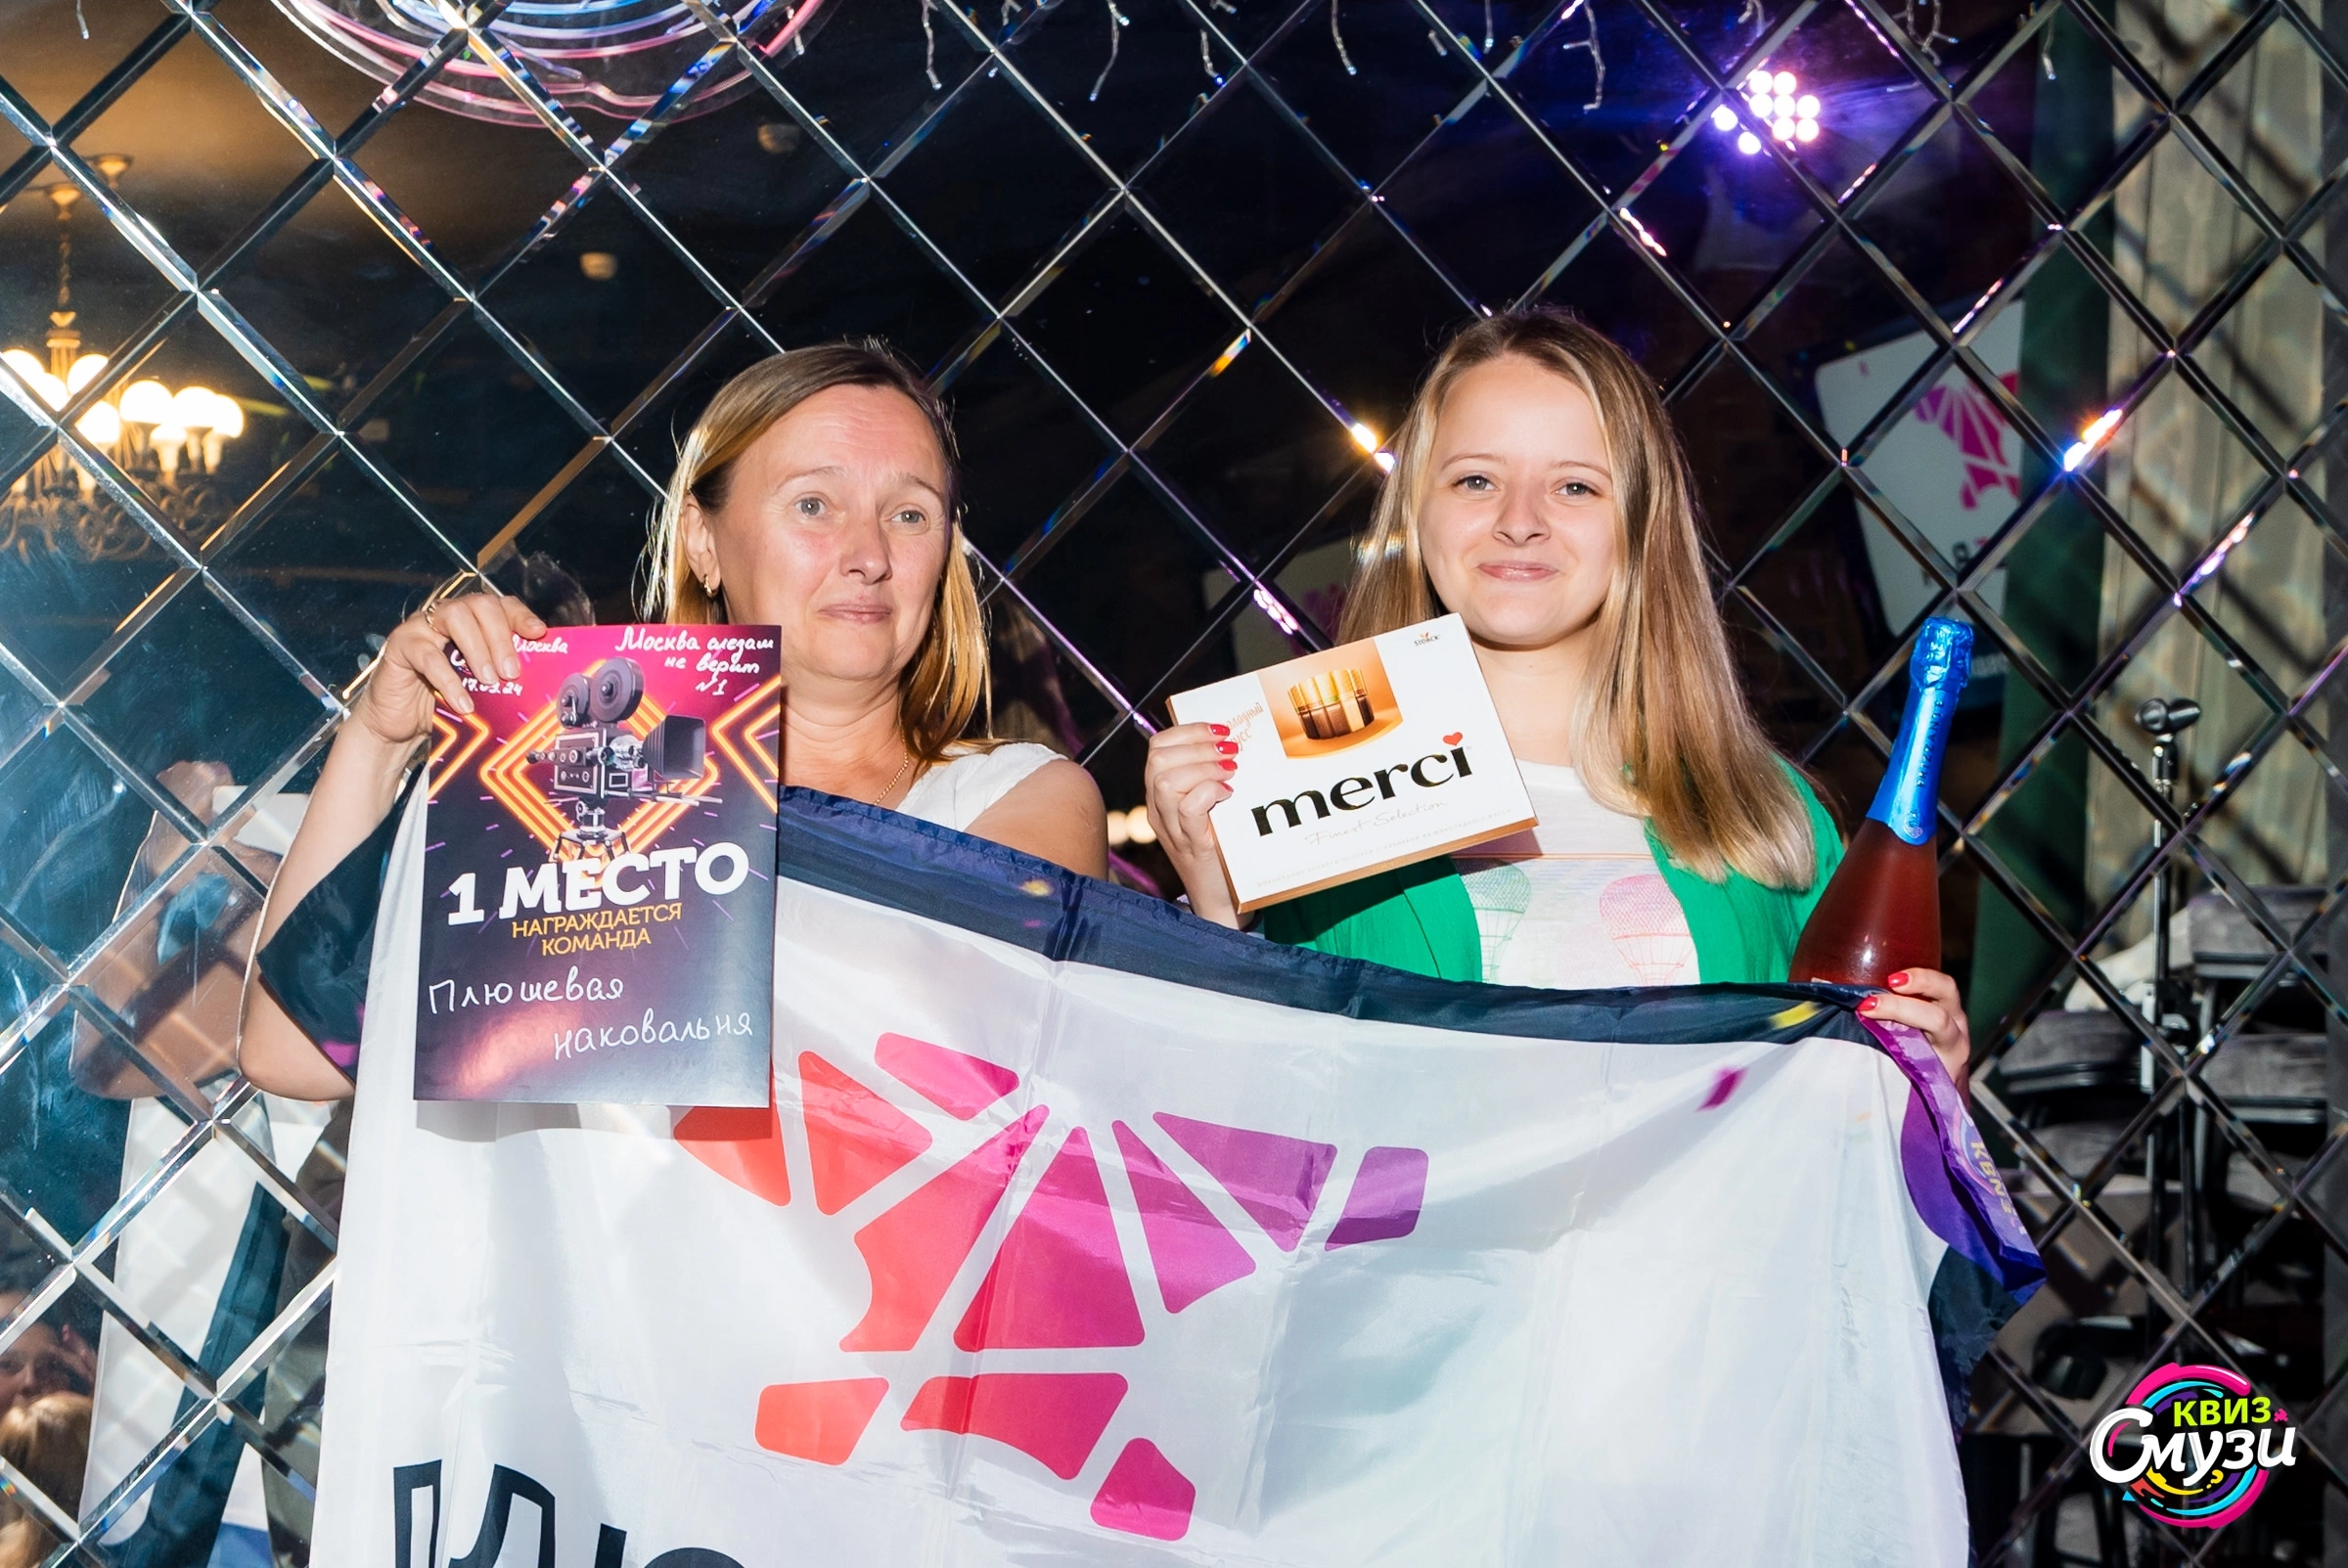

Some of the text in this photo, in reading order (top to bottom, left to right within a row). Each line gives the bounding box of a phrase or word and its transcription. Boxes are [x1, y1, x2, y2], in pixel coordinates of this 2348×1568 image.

[615, 626, 701, 651] Москва
[664, 651, 760, 682] не верит
[1251, 732, 1473, 837] merci
[1304, 801, 1448, 846] Finest Selection
[447, 841, 749, 926] 1 МЕСТО
[512, 902, 683, 939] НАГРАЖДАЕТСЯ
[541, 928, 652, 957] КОМАНДА
[429, 965, 625, 1014] Плюшевая
[553, 1008, 753, 1060] наковальня
